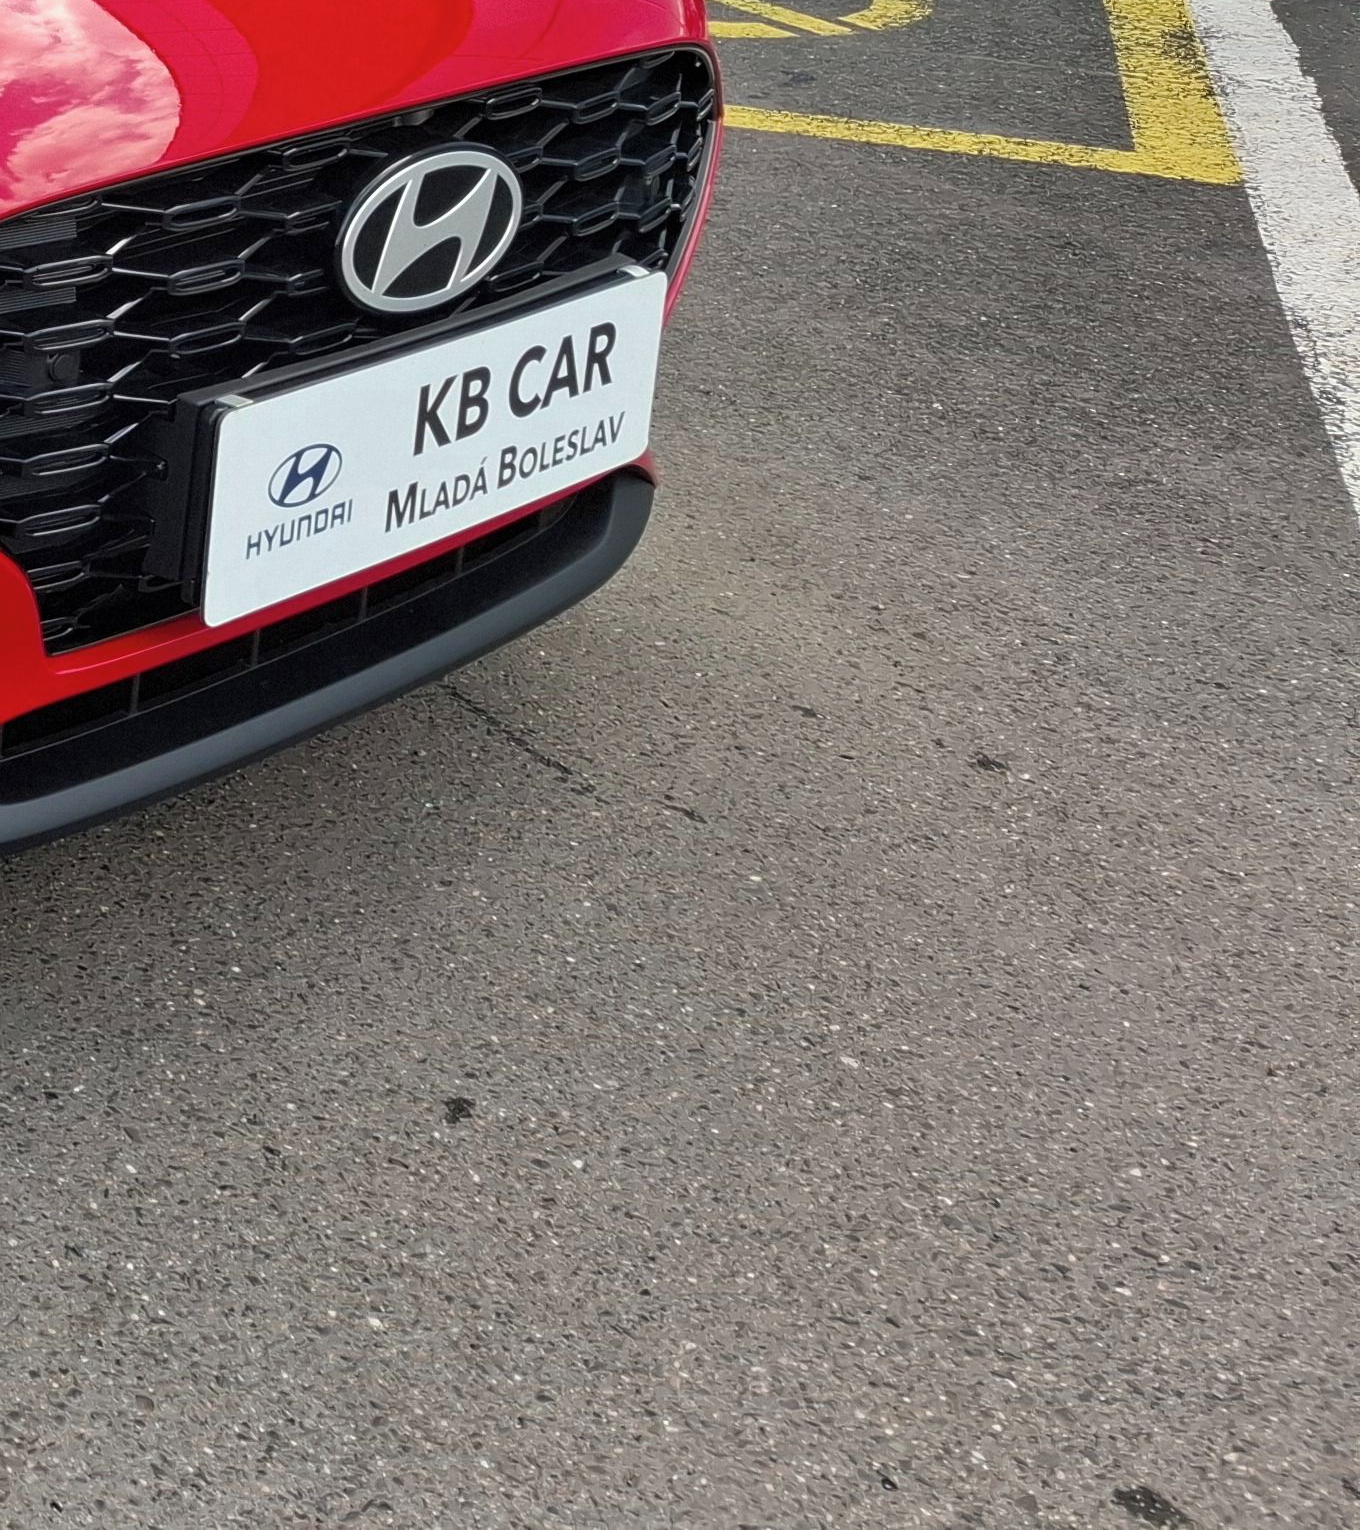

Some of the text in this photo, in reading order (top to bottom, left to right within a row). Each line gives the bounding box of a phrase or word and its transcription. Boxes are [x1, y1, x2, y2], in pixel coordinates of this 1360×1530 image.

[413, 321, 617, 457] KB CAR
[246, 499, 353, 560] HYUNDAI
[384, 411, 626, 533] MLADÁ BOLESLAV
